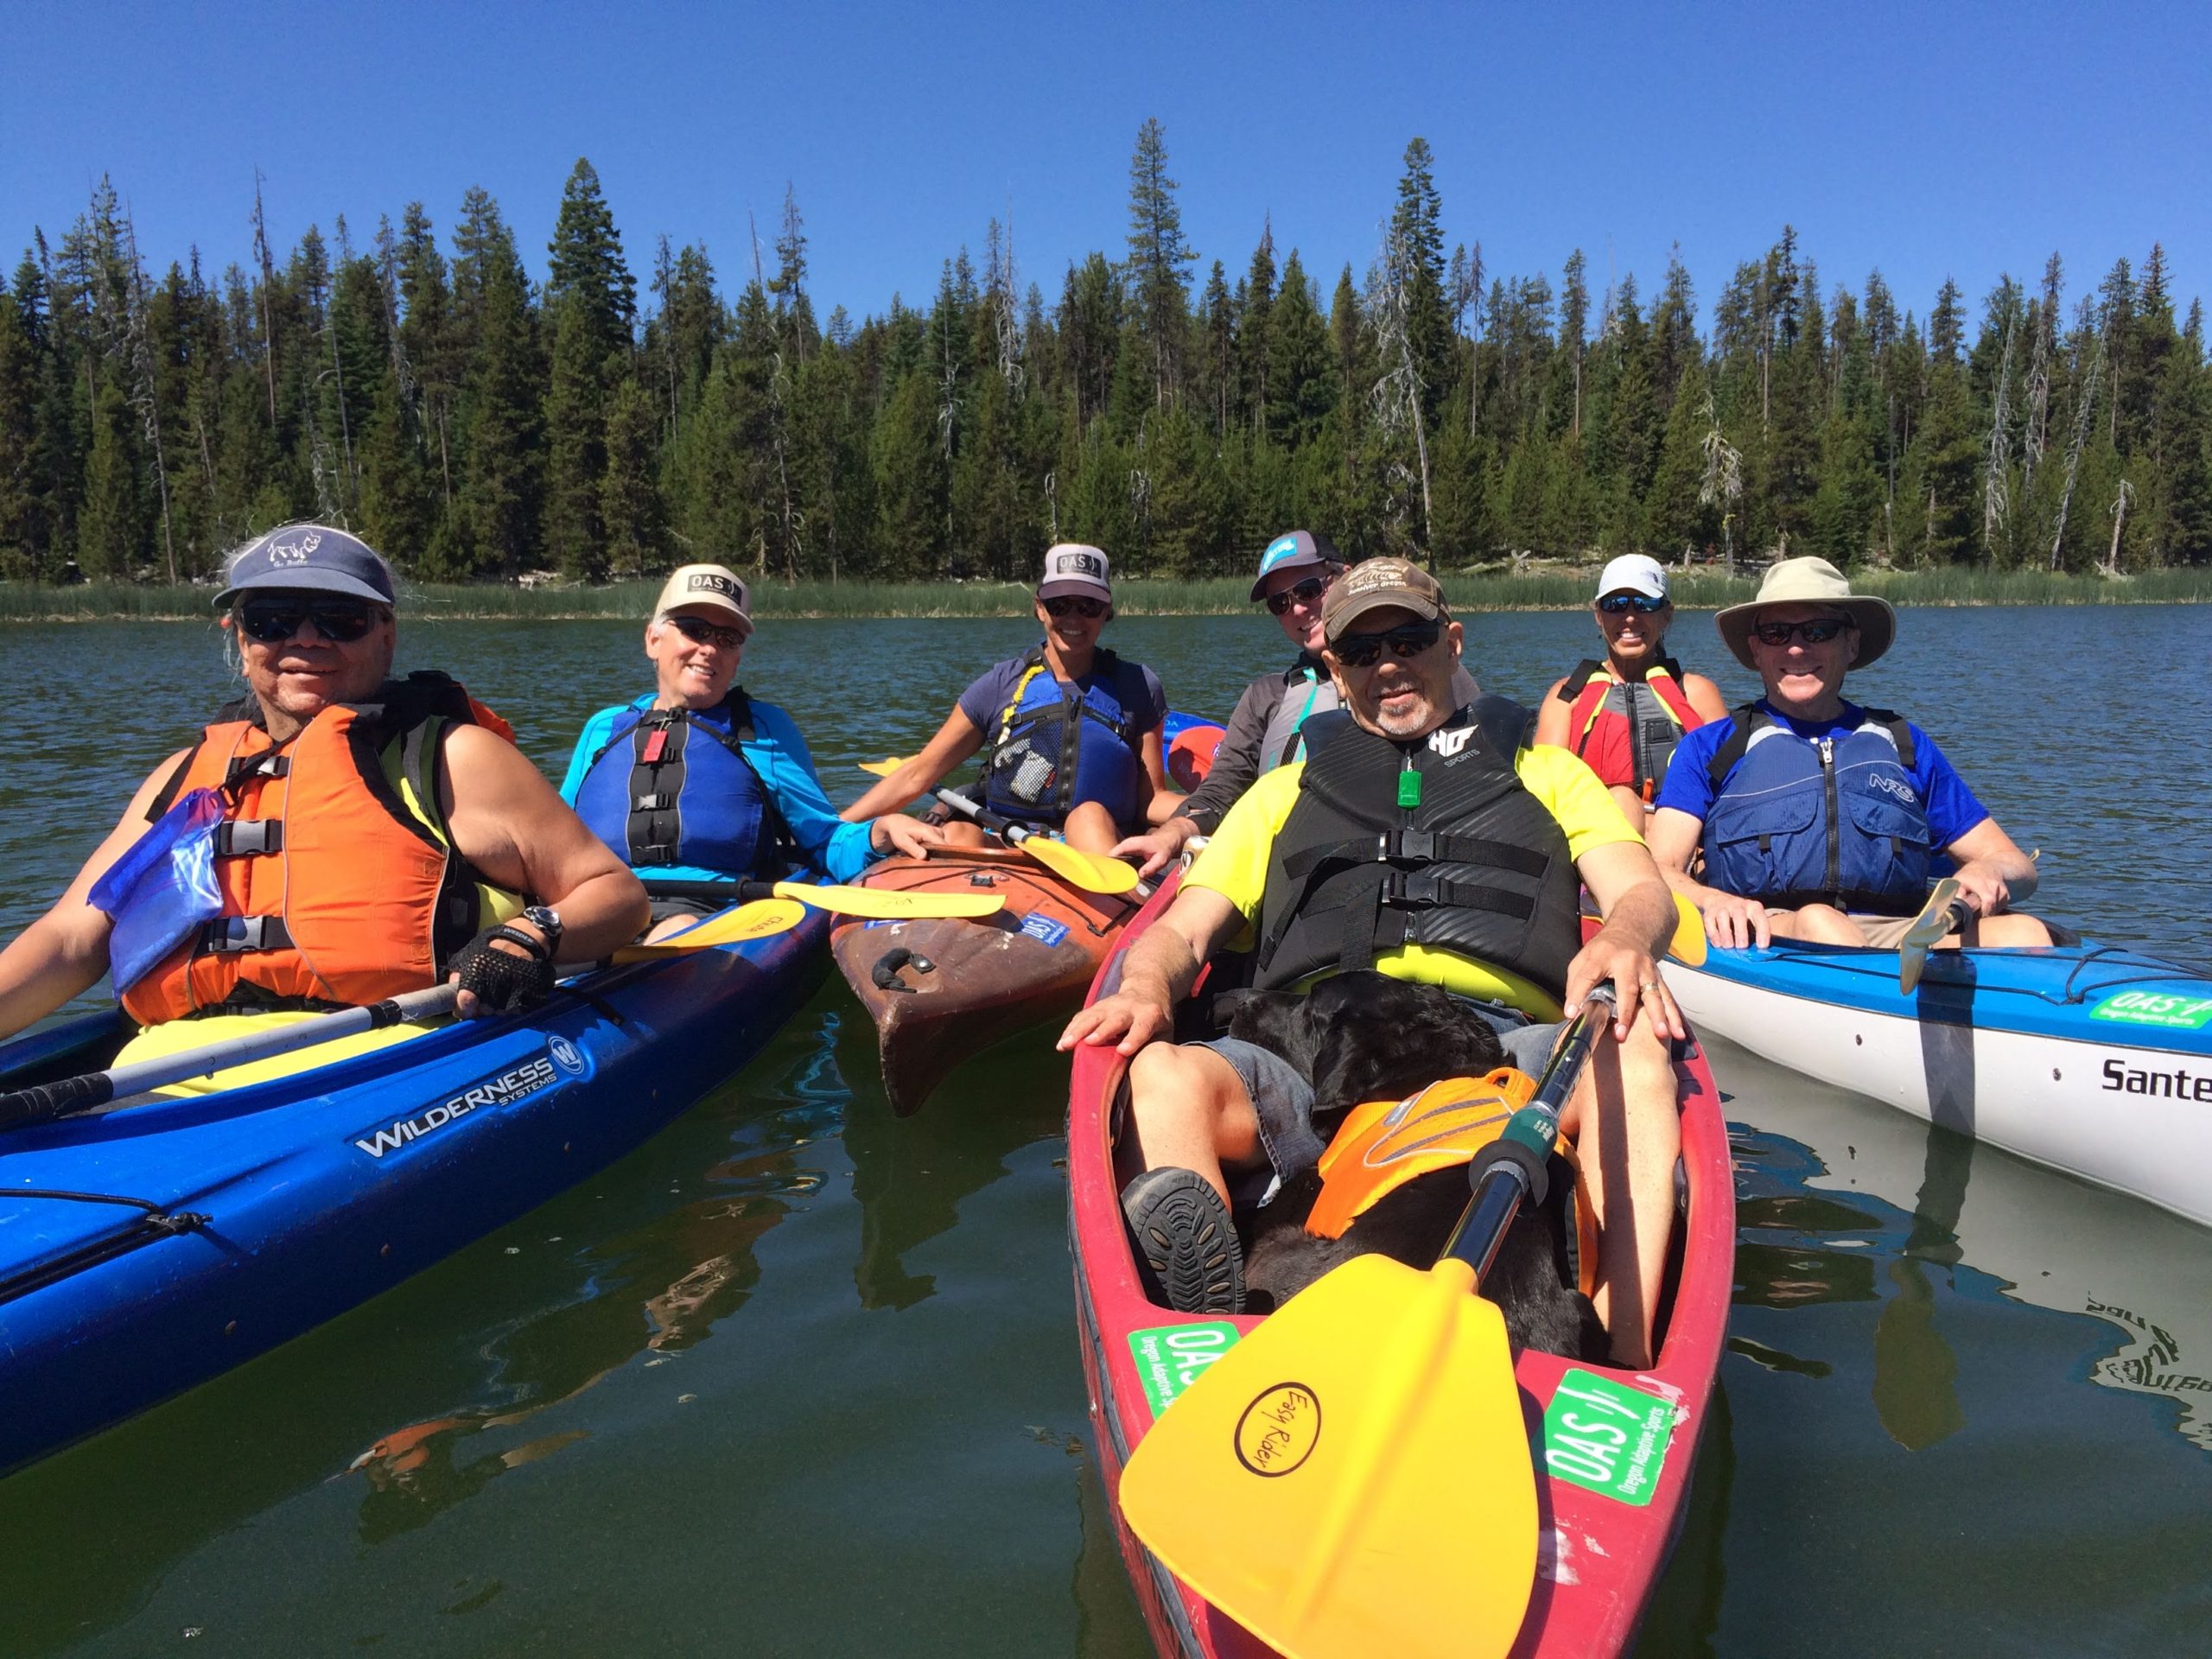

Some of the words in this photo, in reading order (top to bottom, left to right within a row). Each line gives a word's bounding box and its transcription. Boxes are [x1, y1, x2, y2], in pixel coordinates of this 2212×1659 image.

[1059, 556, 1086, 569] OAS
[691, 575, 724, 589] OAS
[1444, 749, 1481, 768] SPORTS
[1869, 772, 1914, 803] NRS
[2111, 992, 2186, 1013] OAS
[498, 1072, 557, 1106] SYSTEMS
[355, 1057, 555, 1158] WILDERNESS
[1141, 1335, 1161, 1363] Oregon
[1149, 1363, 1174, 1397] Adaptive
[1261, 1390, 1308, 1425] Easy
[1641, 1407, 1666, 1433] Sports
[1253, 1425, 1291, 1469] Rider
[1545, 1412, 1627, 1482] OAS
[1629, 1430, 1656, 1465] Adaptive
[1617, 1465, 1647, 1495] Oregon
